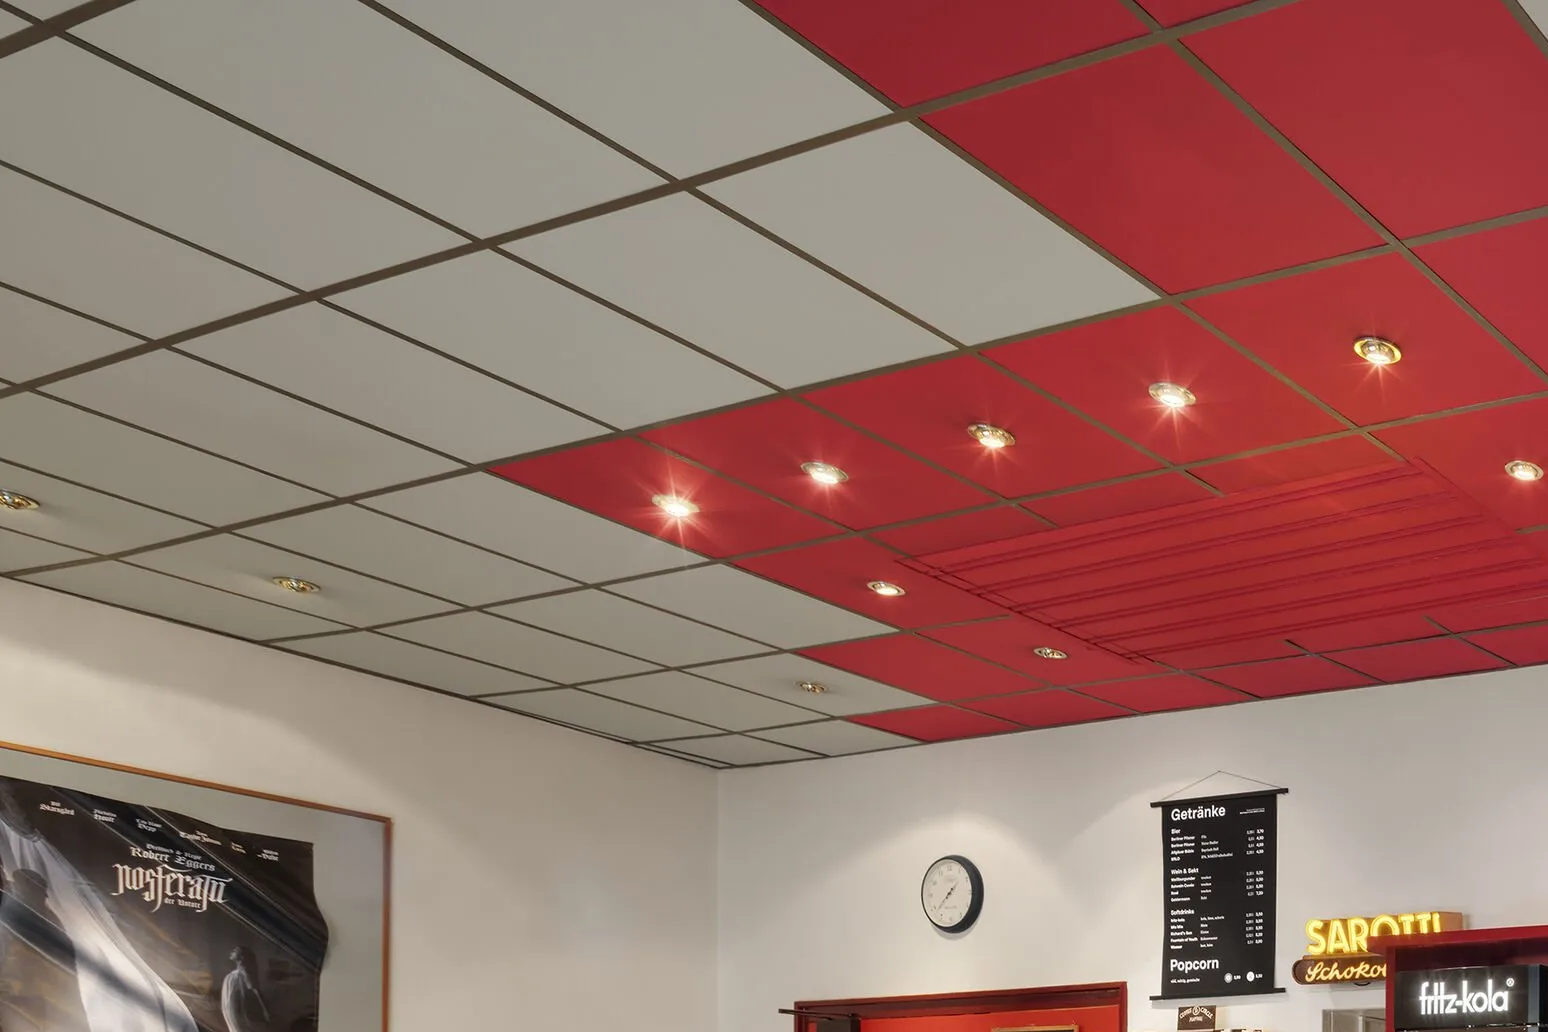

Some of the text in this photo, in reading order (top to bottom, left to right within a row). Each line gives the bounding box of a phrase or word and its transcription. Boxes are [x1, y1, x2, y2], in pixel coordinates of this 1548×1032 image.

[1171, 805, 1226, 821] Getränke
[130, 846, 216, 872] Robert Eggers
[1305, 912, 1441, 955] SAROTTI
[1170, 959, 1219, 974] Popcorn
[1419, 979, 1509, 1015] fritz-kola
